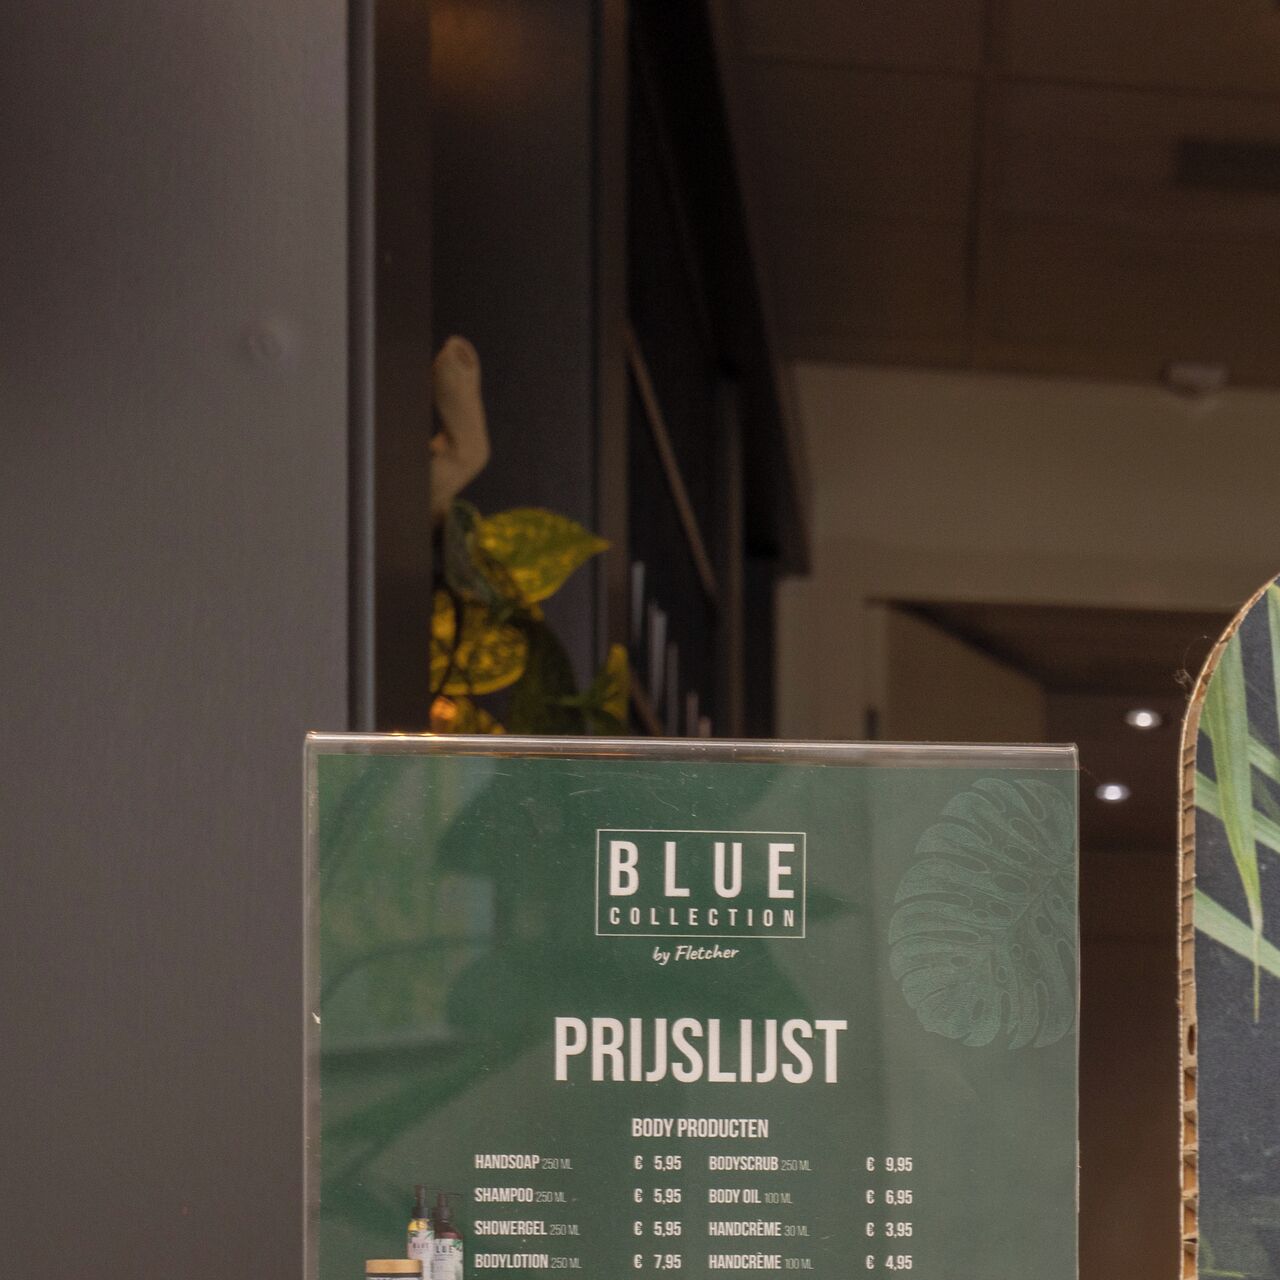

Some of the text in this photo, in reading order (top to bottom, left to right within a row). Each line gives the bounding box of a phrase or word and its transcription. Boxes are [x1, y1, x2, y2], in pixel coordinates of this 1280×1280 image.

[608, 840, 795, 899] BLUE
[608, 906, 795, 927] COLLECTION
[653, 944, 739, 965] by Fletcher
[554, 1016, 848, 1084] PRIJSLIJST
[631, 1118, 769, 1139] BODY PRODUCTEN
[474, 1154, 540, 1169] HANDSOAP
[541, 1158, 559, 1170] 250
[634, 1156, 643, 1170] €
[654, 1156, 682, 1171] 5,95
[709, 1156, 779, 1171] BODYSCRUB
[781, 1160, 798, 1171] 250
[865, 1157, 875, 1171] €
[885, 1157, 913, 1173] 9,95
[474, 1187, 534, 1203] SHAMPOO
[535, 1191, 552, 1203] 250
[634, 1188, 643, 1203] €
[654, 1188, 682, 1204] 5,95
[708, 1189, 740, 1204] BODY
[742, 1189, 761, 1204] OIL
[865, 1190, 875, 1204] €
[885, 1190, 913, 1206] 6,95
[474, 1220, 548, 1236] SHOWERGEL
[550, 1224, 566, 1236] 250
[634, 1221, 643, 1236] €
[654, 1221, 682, 1237] 5,95
[708, 1219, 782, 1237] HANDCRÈME
[784, 1225, 796, 1237] 30
[865, 1222, 875, 1237] €
[885, 1222, 913, 1238] 3,95
[474, 1254, 549, 1269] BODYLOTION
[551, 1257, 568, 1269] 250
[634, 1254, 643, 1269] €
[654, 1254, 682, 1270] 7,95
[708, 1253, 782, 1269] HANDCRÈME
[865, 1255, 875, 1270] €
[885, 1255, 913, 1271] 4,95
